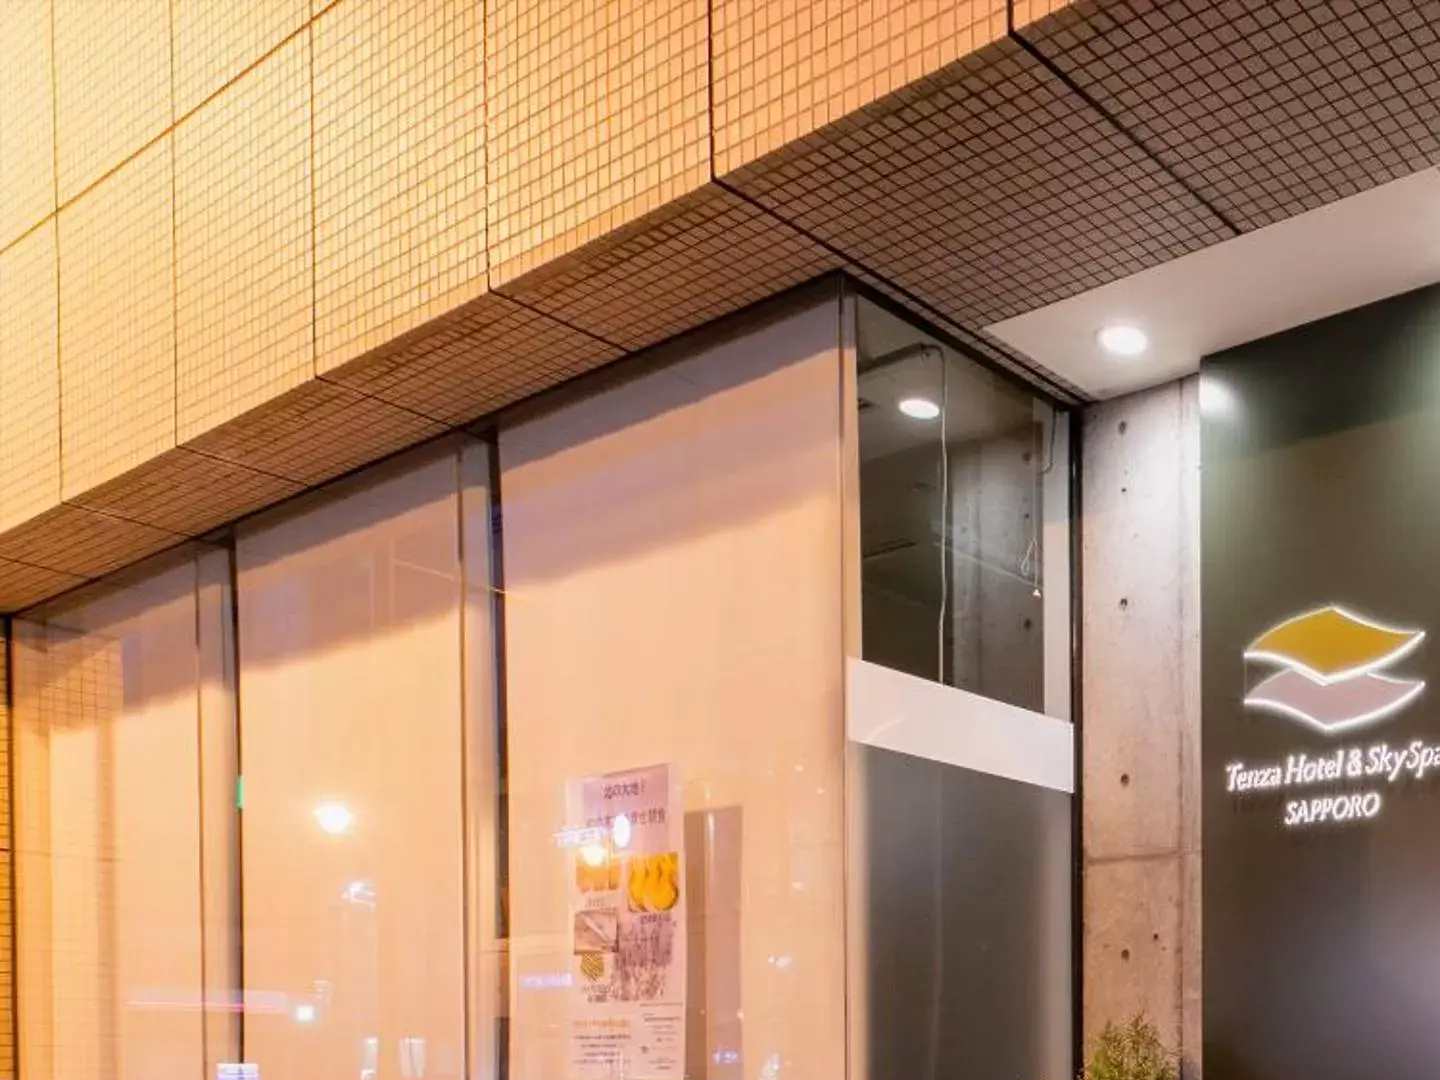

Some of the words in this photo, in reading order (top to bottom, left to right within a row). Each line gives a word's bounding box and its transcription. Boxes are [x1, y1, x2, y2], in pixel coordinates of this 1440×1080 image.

[1226, 762, 1283, 791] Tenza
[1284, 750, 1345, 784] Hotel
[1346, 749, 1363, 777] &
[1364, 744, 1407, 782] Sky
[1284, 792, 1381, 825] SAPPORO
